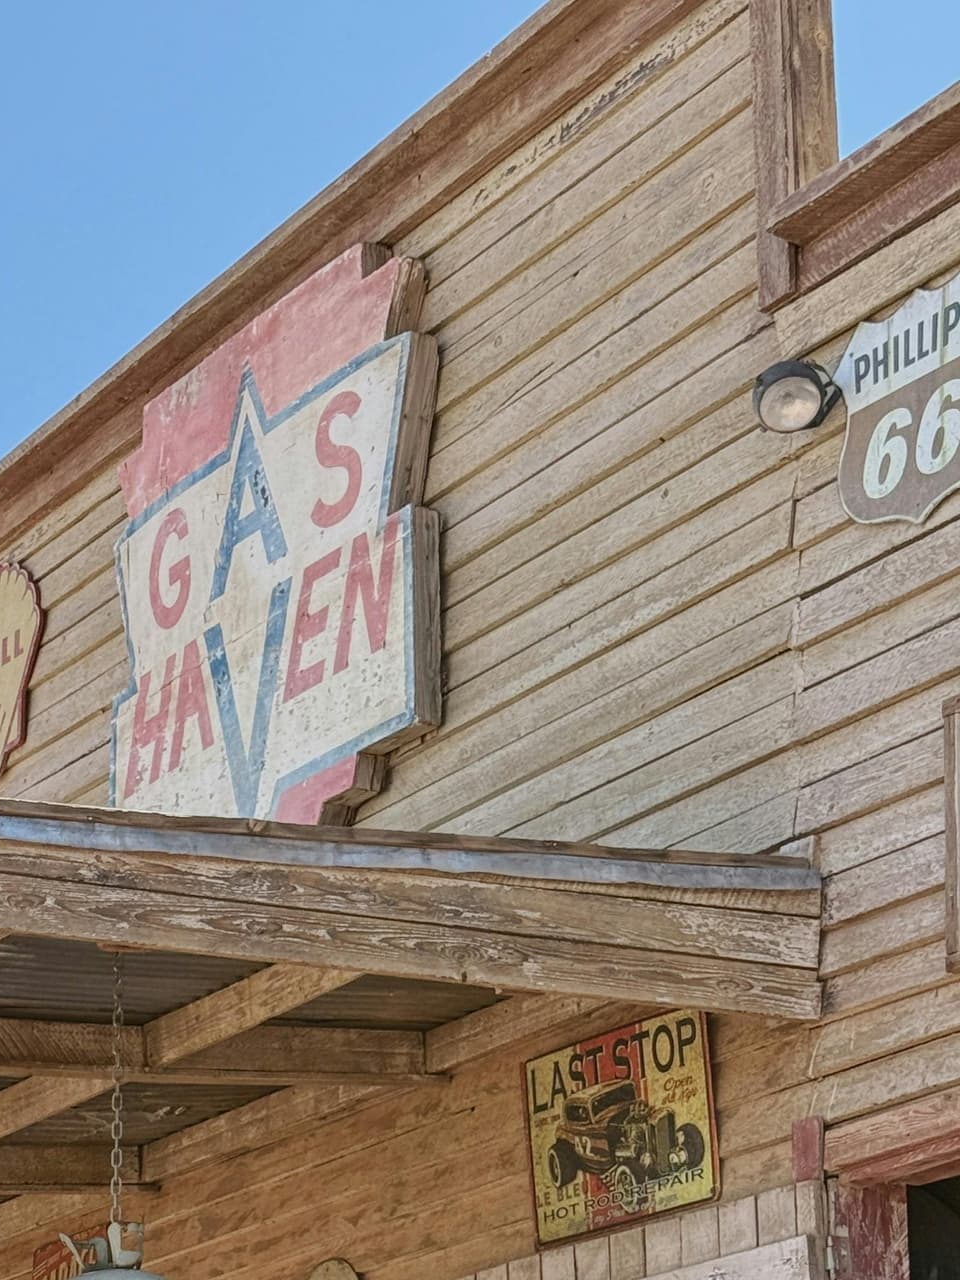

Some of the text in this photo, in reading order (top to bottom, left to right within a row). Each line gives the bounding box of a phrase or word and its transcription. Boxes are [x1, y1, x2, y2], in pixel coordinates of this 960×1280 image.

[862, 378, 960, 499] 66
[149, 390, 362, 629] GAS
[123, 512, 402, 818] HAVEN
[530, 1016, 697, 1115] LAST STOP
[543, 1201, 580, 1224] HOT
[584, 1189, 624, 1212] ROD
[629, 1168, 705, 1199] REPAIR
